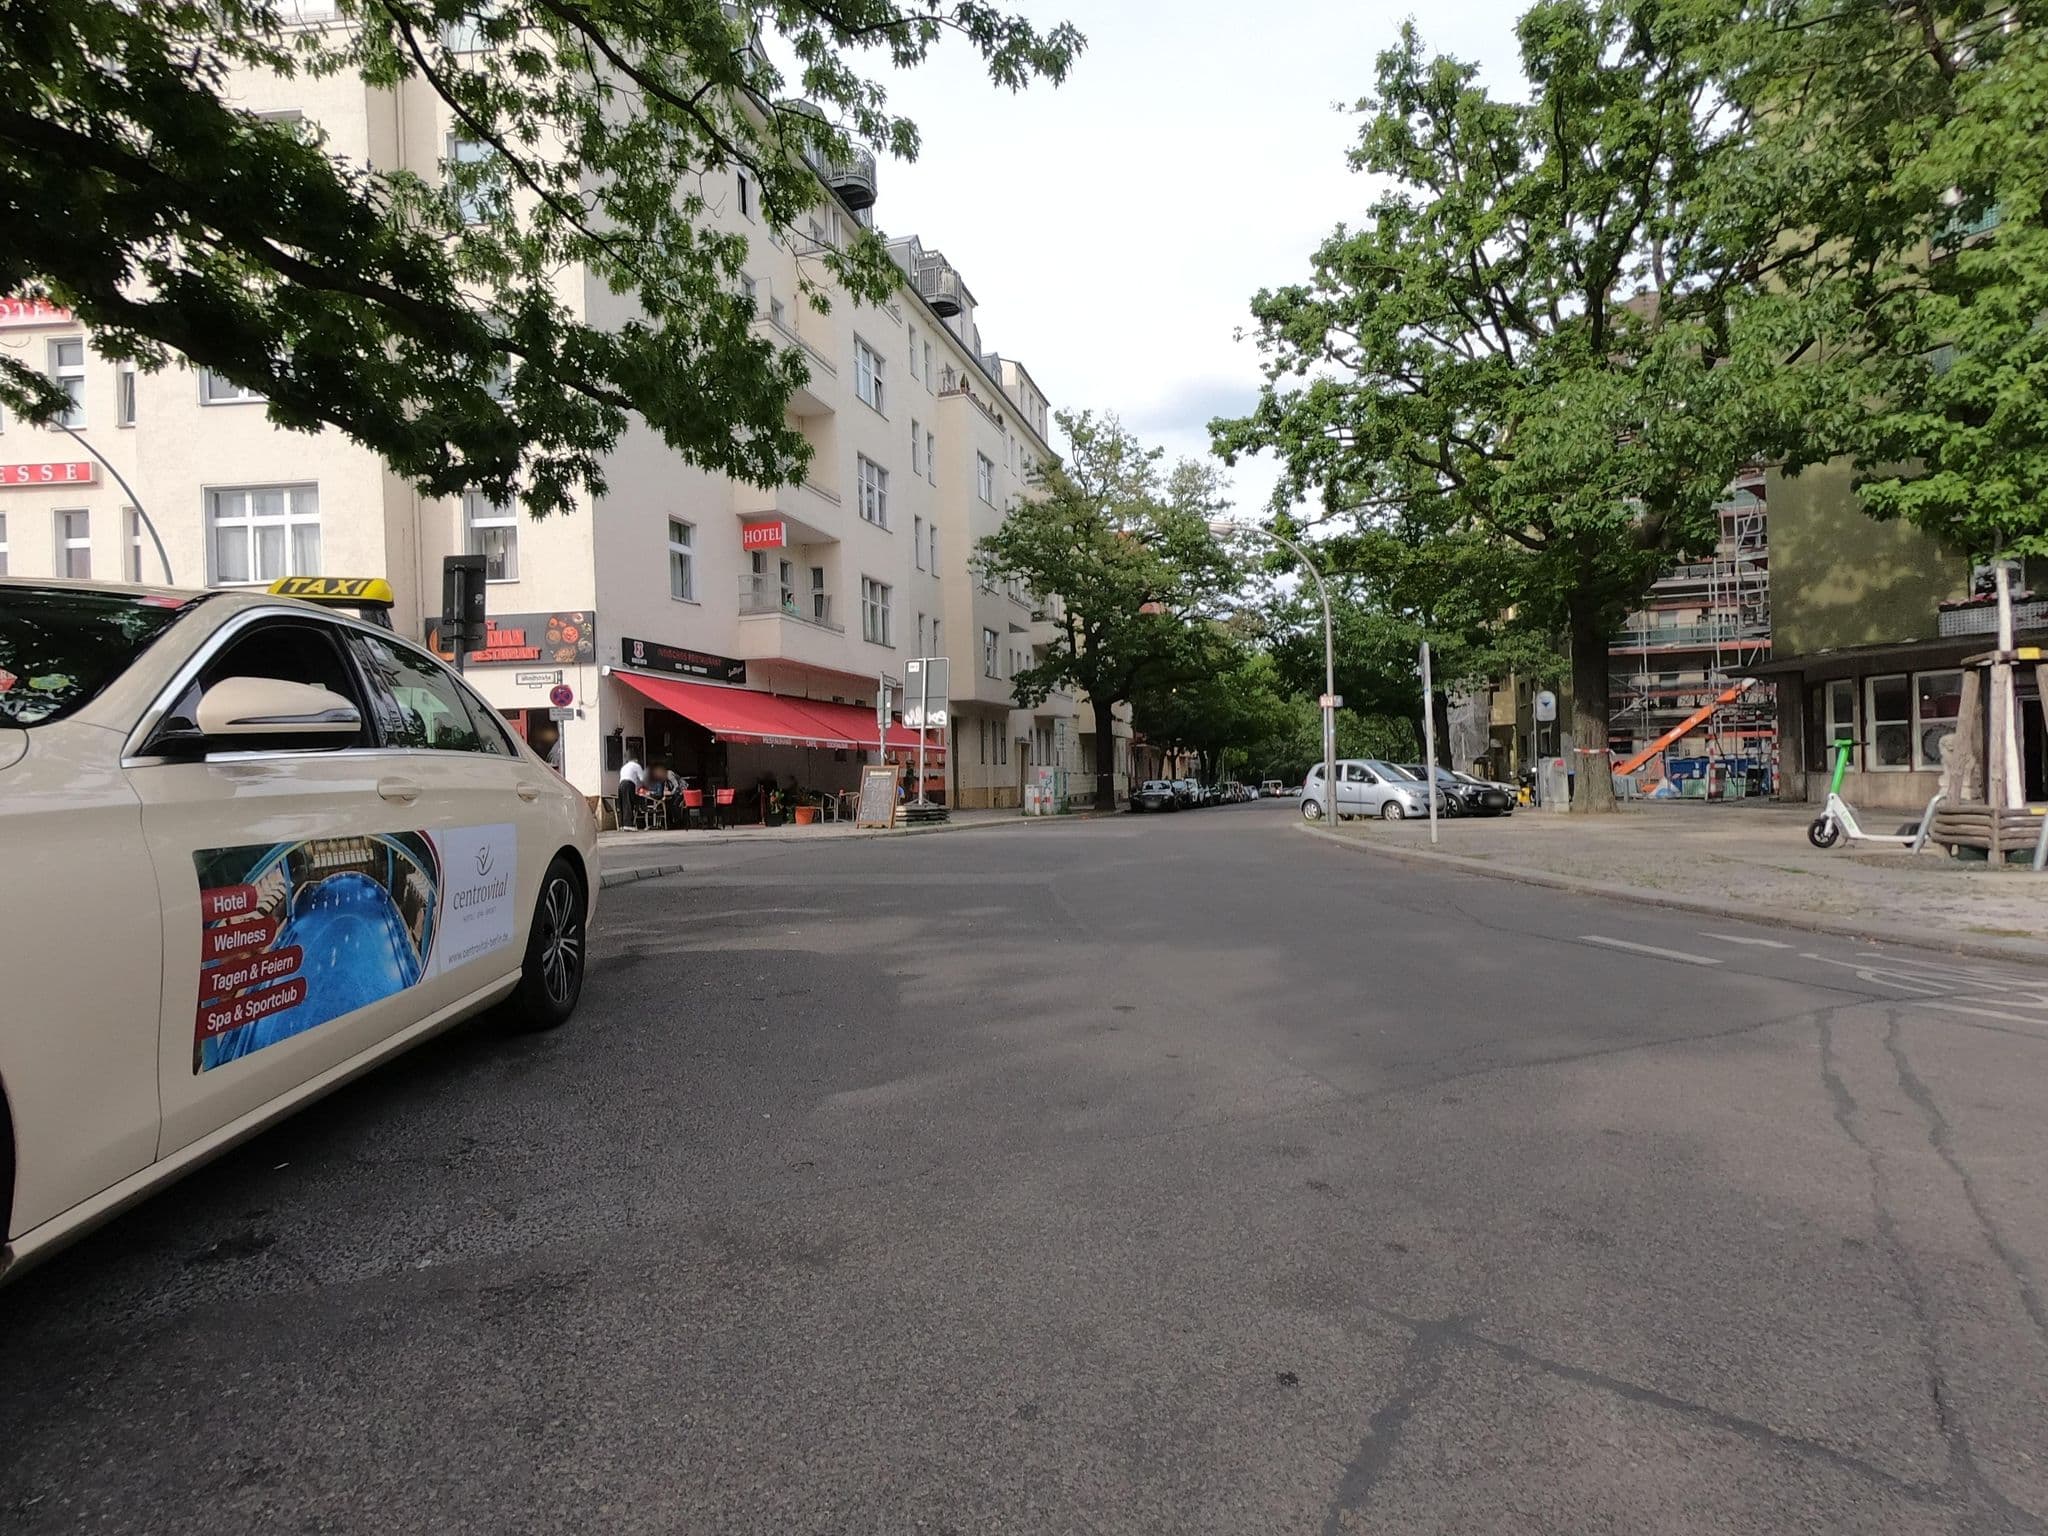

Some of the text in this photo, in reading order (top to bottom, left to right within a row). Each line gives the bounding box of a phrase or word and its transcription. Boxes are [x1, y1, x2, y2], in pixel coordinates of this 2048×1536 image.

[744, 527, 782, 544] HOTEL
[288, 579, 369, 595] TAXI
[213, 892, 248, 914] Hotel
[453, 872, 508, 911] centrovital
[214, 928, 267, 952] Wellness
[212, 955, 294, 992] Tagen & Feiern
[207, 986, 298, 1032] Spa & Sportclub
